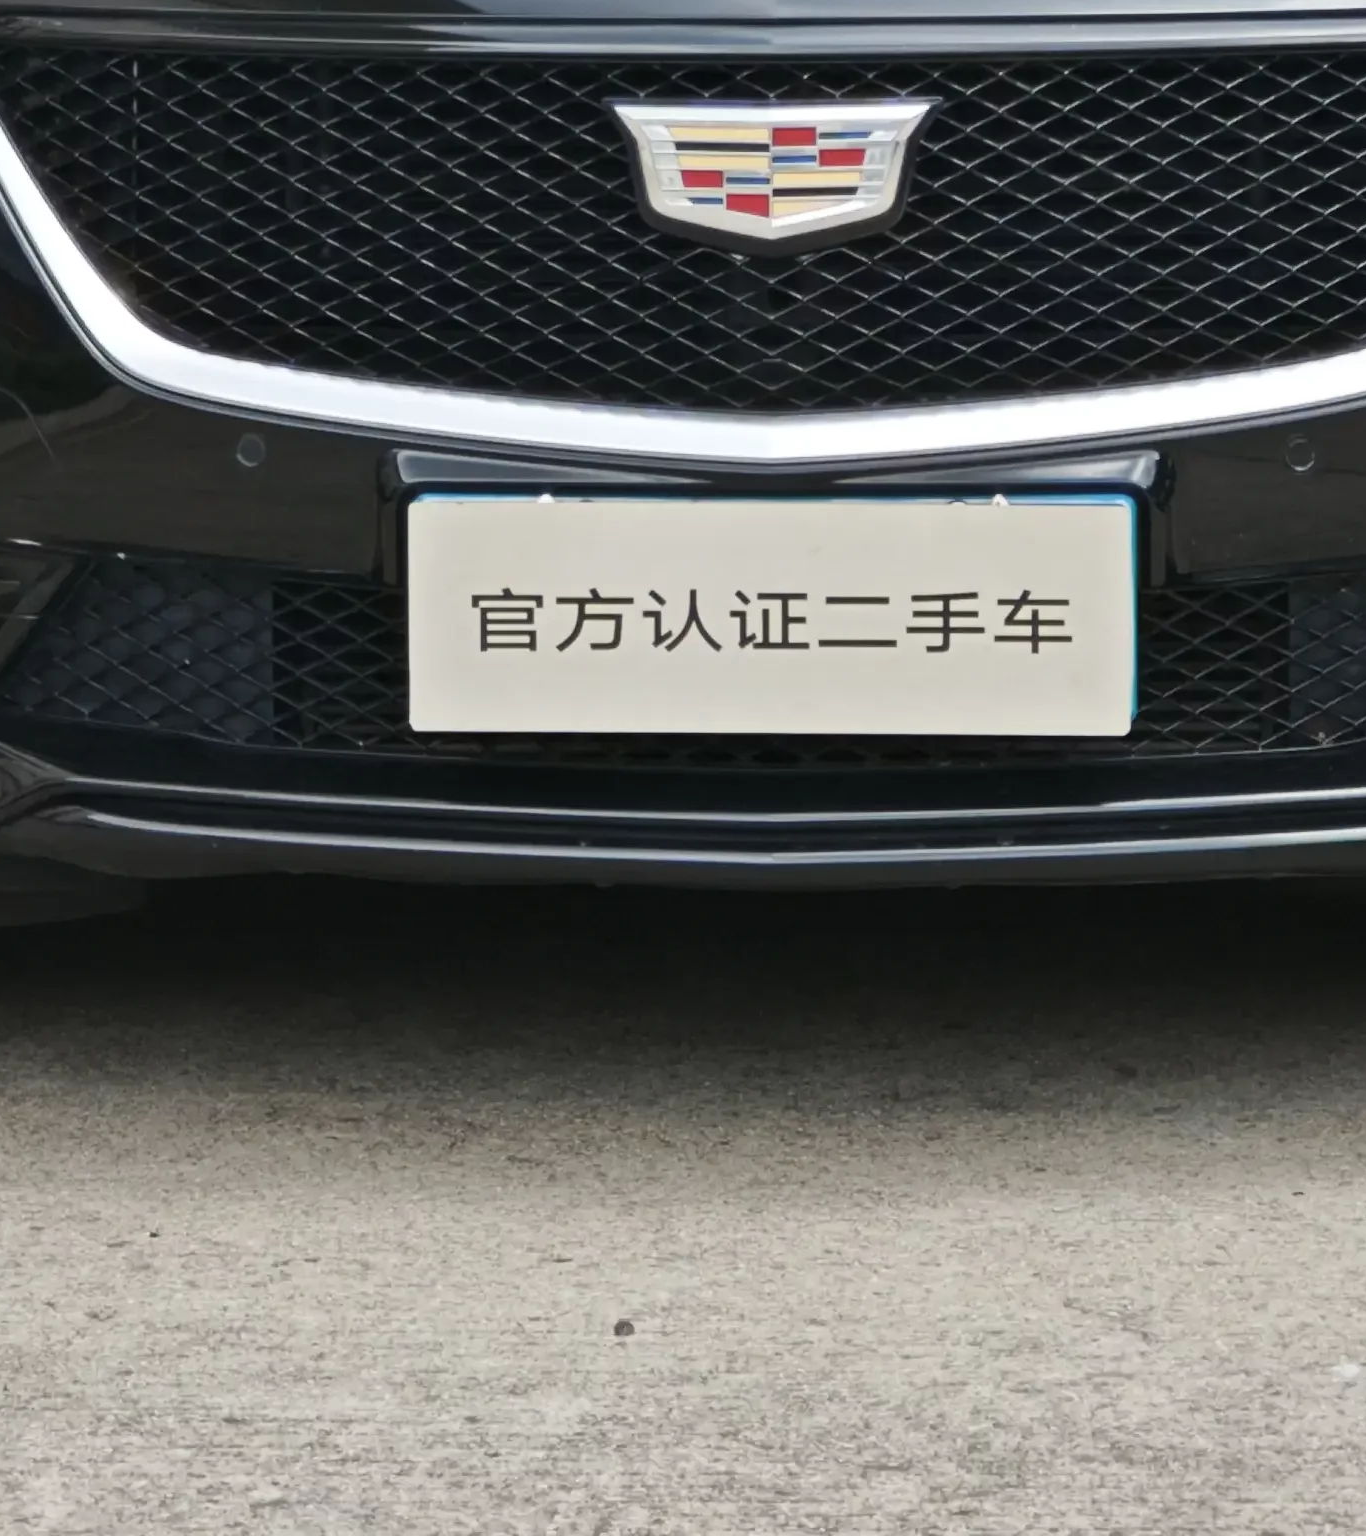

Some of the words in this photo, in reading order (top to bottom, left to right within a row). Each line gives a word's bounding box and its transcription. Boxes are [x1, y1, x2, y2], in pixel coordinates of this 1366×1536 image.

[470, 587, 1074, 655] 官方认证二手车
